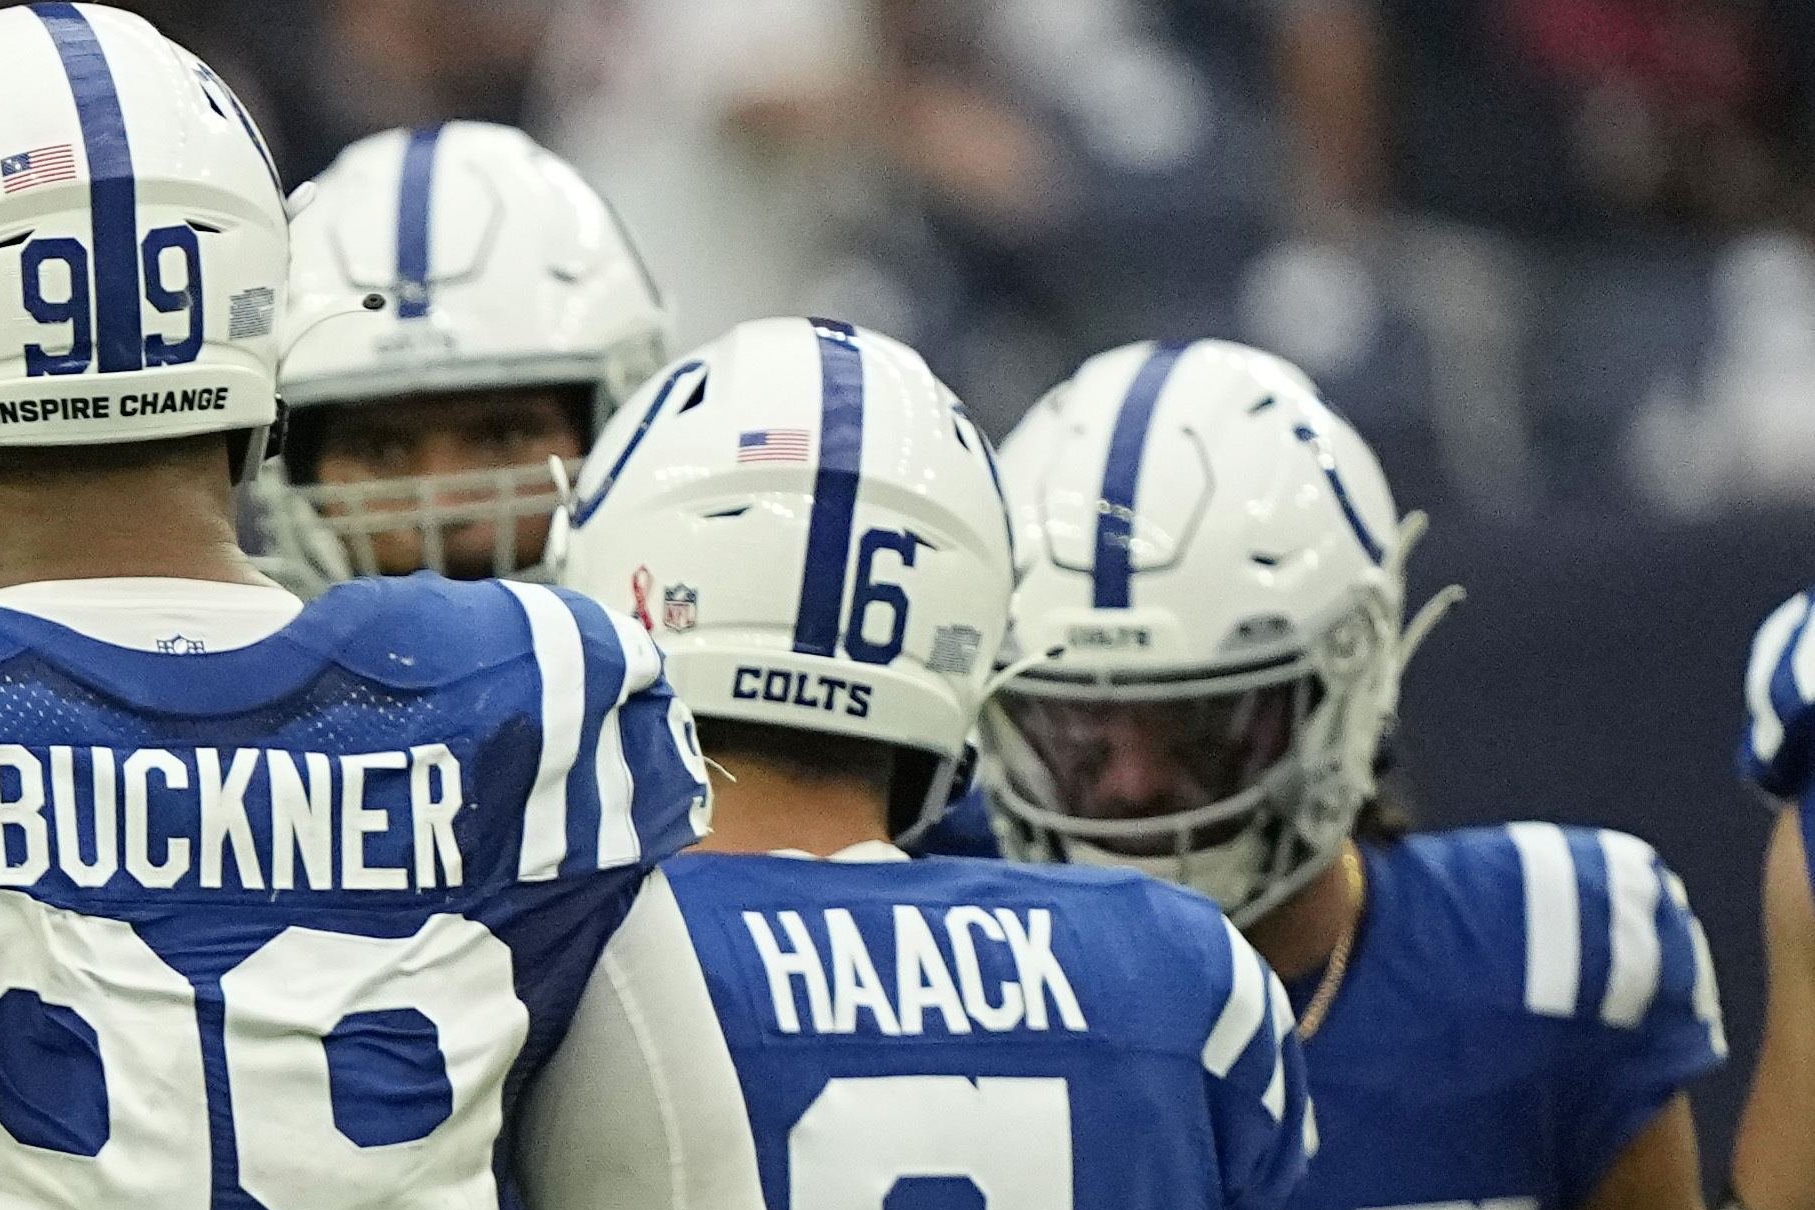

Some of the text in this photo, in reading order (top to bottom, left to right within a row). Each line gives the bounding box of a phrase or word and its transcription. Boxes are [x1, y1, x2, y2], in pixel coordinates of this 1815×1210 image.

[20, 224, 203, 378] 99
[119, 386, 229, 417] CHANGE
[844, 526, 917, 666] 6
[732, 667, 873, 718] COLTS
[744, 905, 1088, 1036] HAACK
